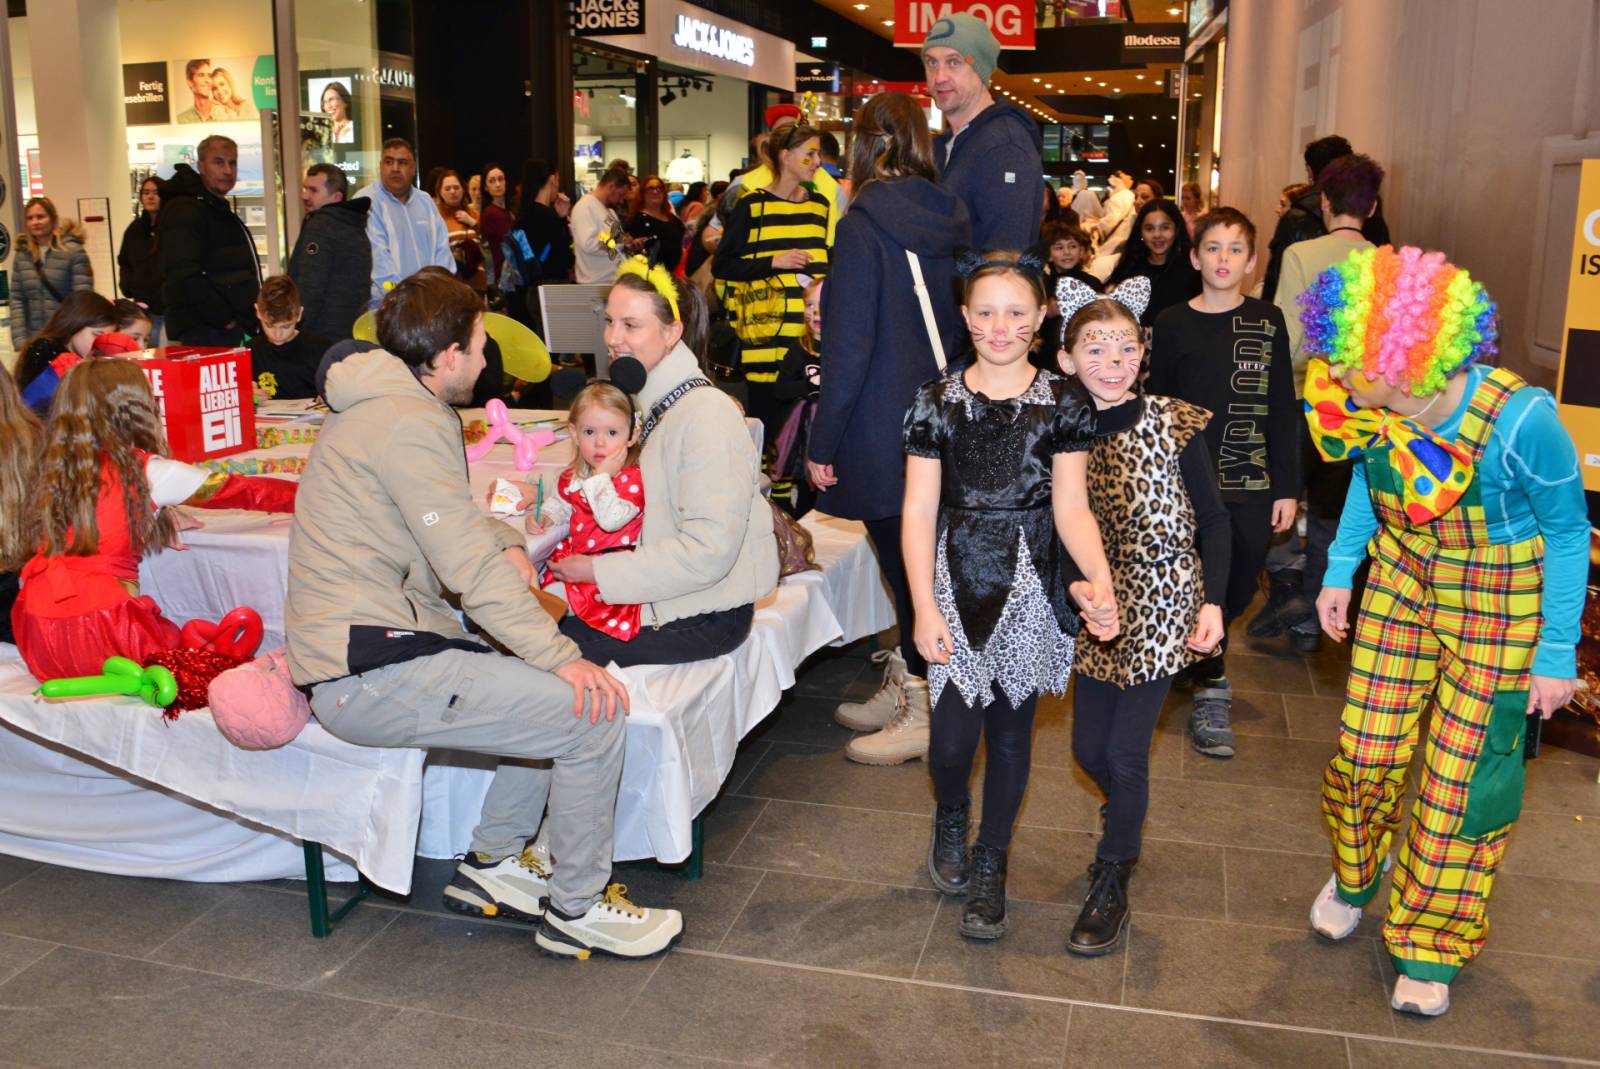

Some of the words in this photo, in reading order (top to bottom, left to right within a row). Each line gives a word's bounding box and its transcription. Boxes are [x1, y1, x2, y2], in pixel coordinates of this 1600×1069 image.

[576, 11, 640, 29] JONES
[909, 2, 953, 33] IM
[1124, 34, 1181, 46] Modessa
[139, 81, 164, 93] Fertig
[124, 93, 164, 104] esebrillen
[200, 361, 238, 394] ALLE
[200, 388, 240, 413] LIEBEN
[202, 407, 243, 453] Eli
